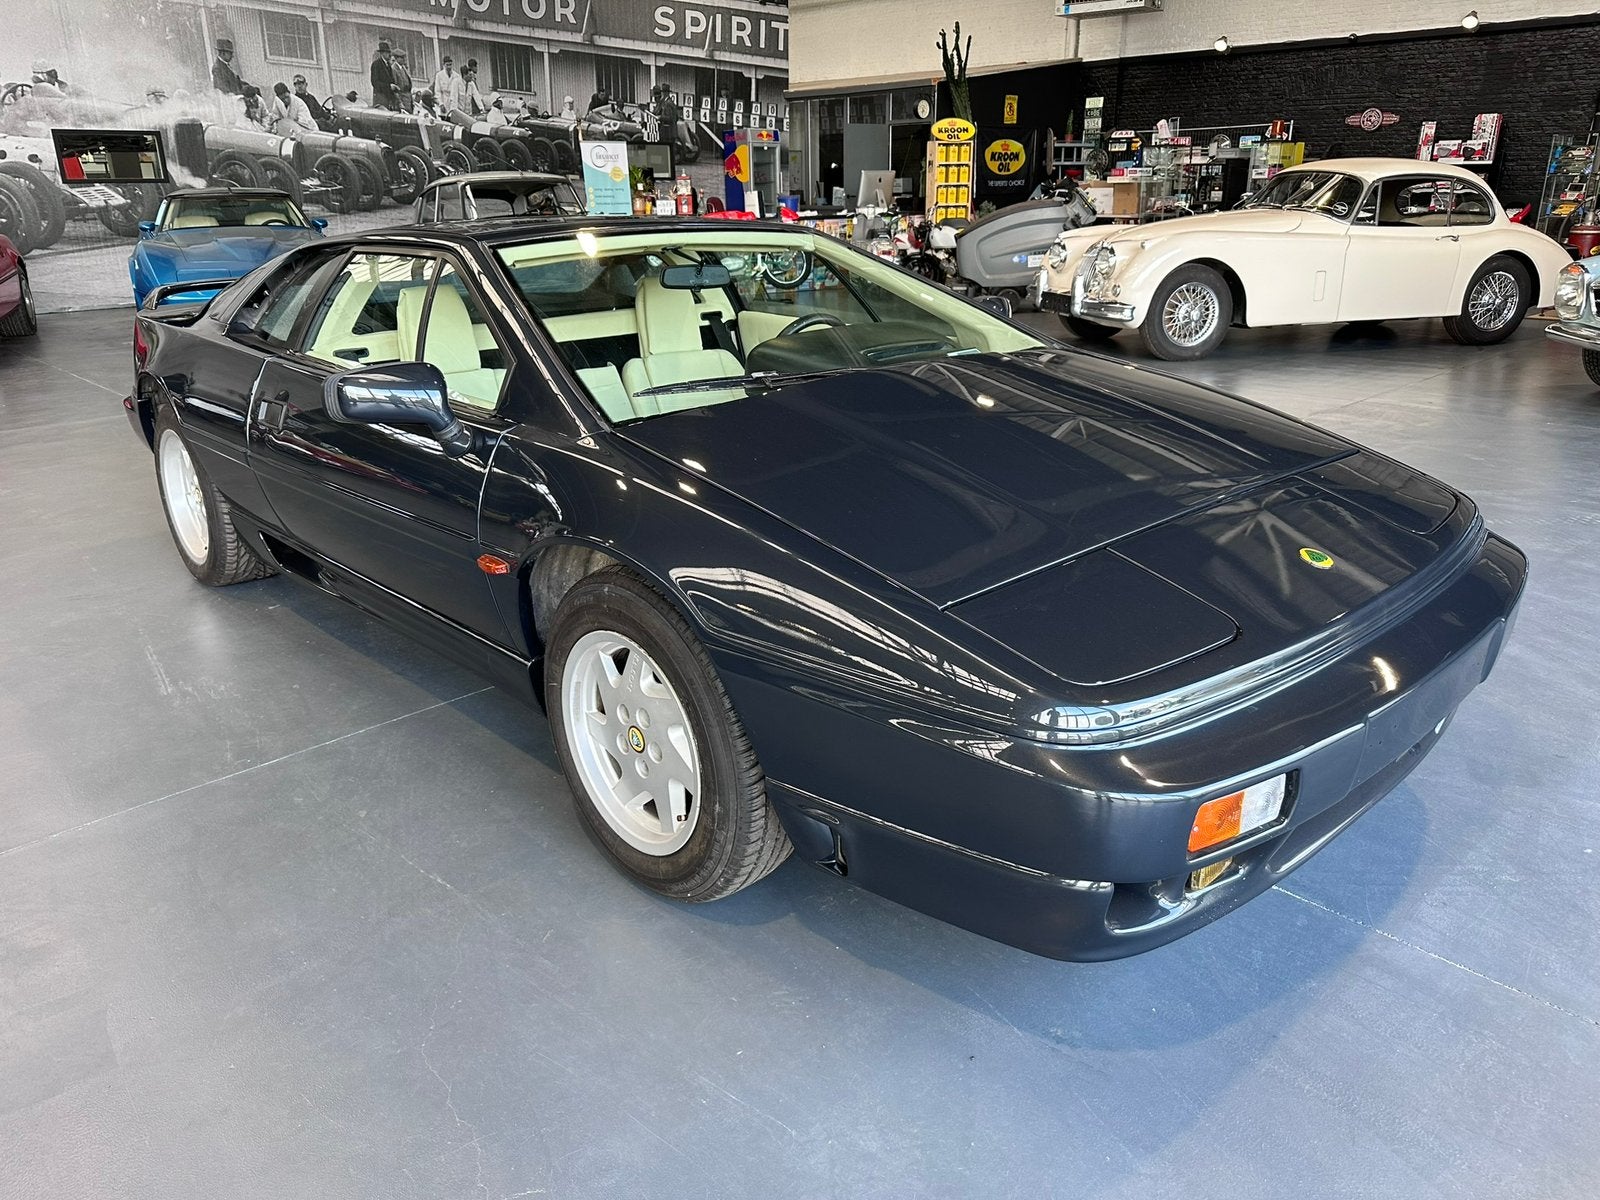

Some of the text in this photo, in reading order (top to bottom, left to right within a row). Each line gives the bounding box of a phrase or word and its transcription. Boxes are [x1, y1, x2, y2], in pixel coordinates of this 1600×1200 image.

[653, 5, 789, 51] SPIRIT
[937, 126, 969, 134] KROON
[990, 151, 1020, 162] KROON
[997, 161, 1011, 173] OIL
